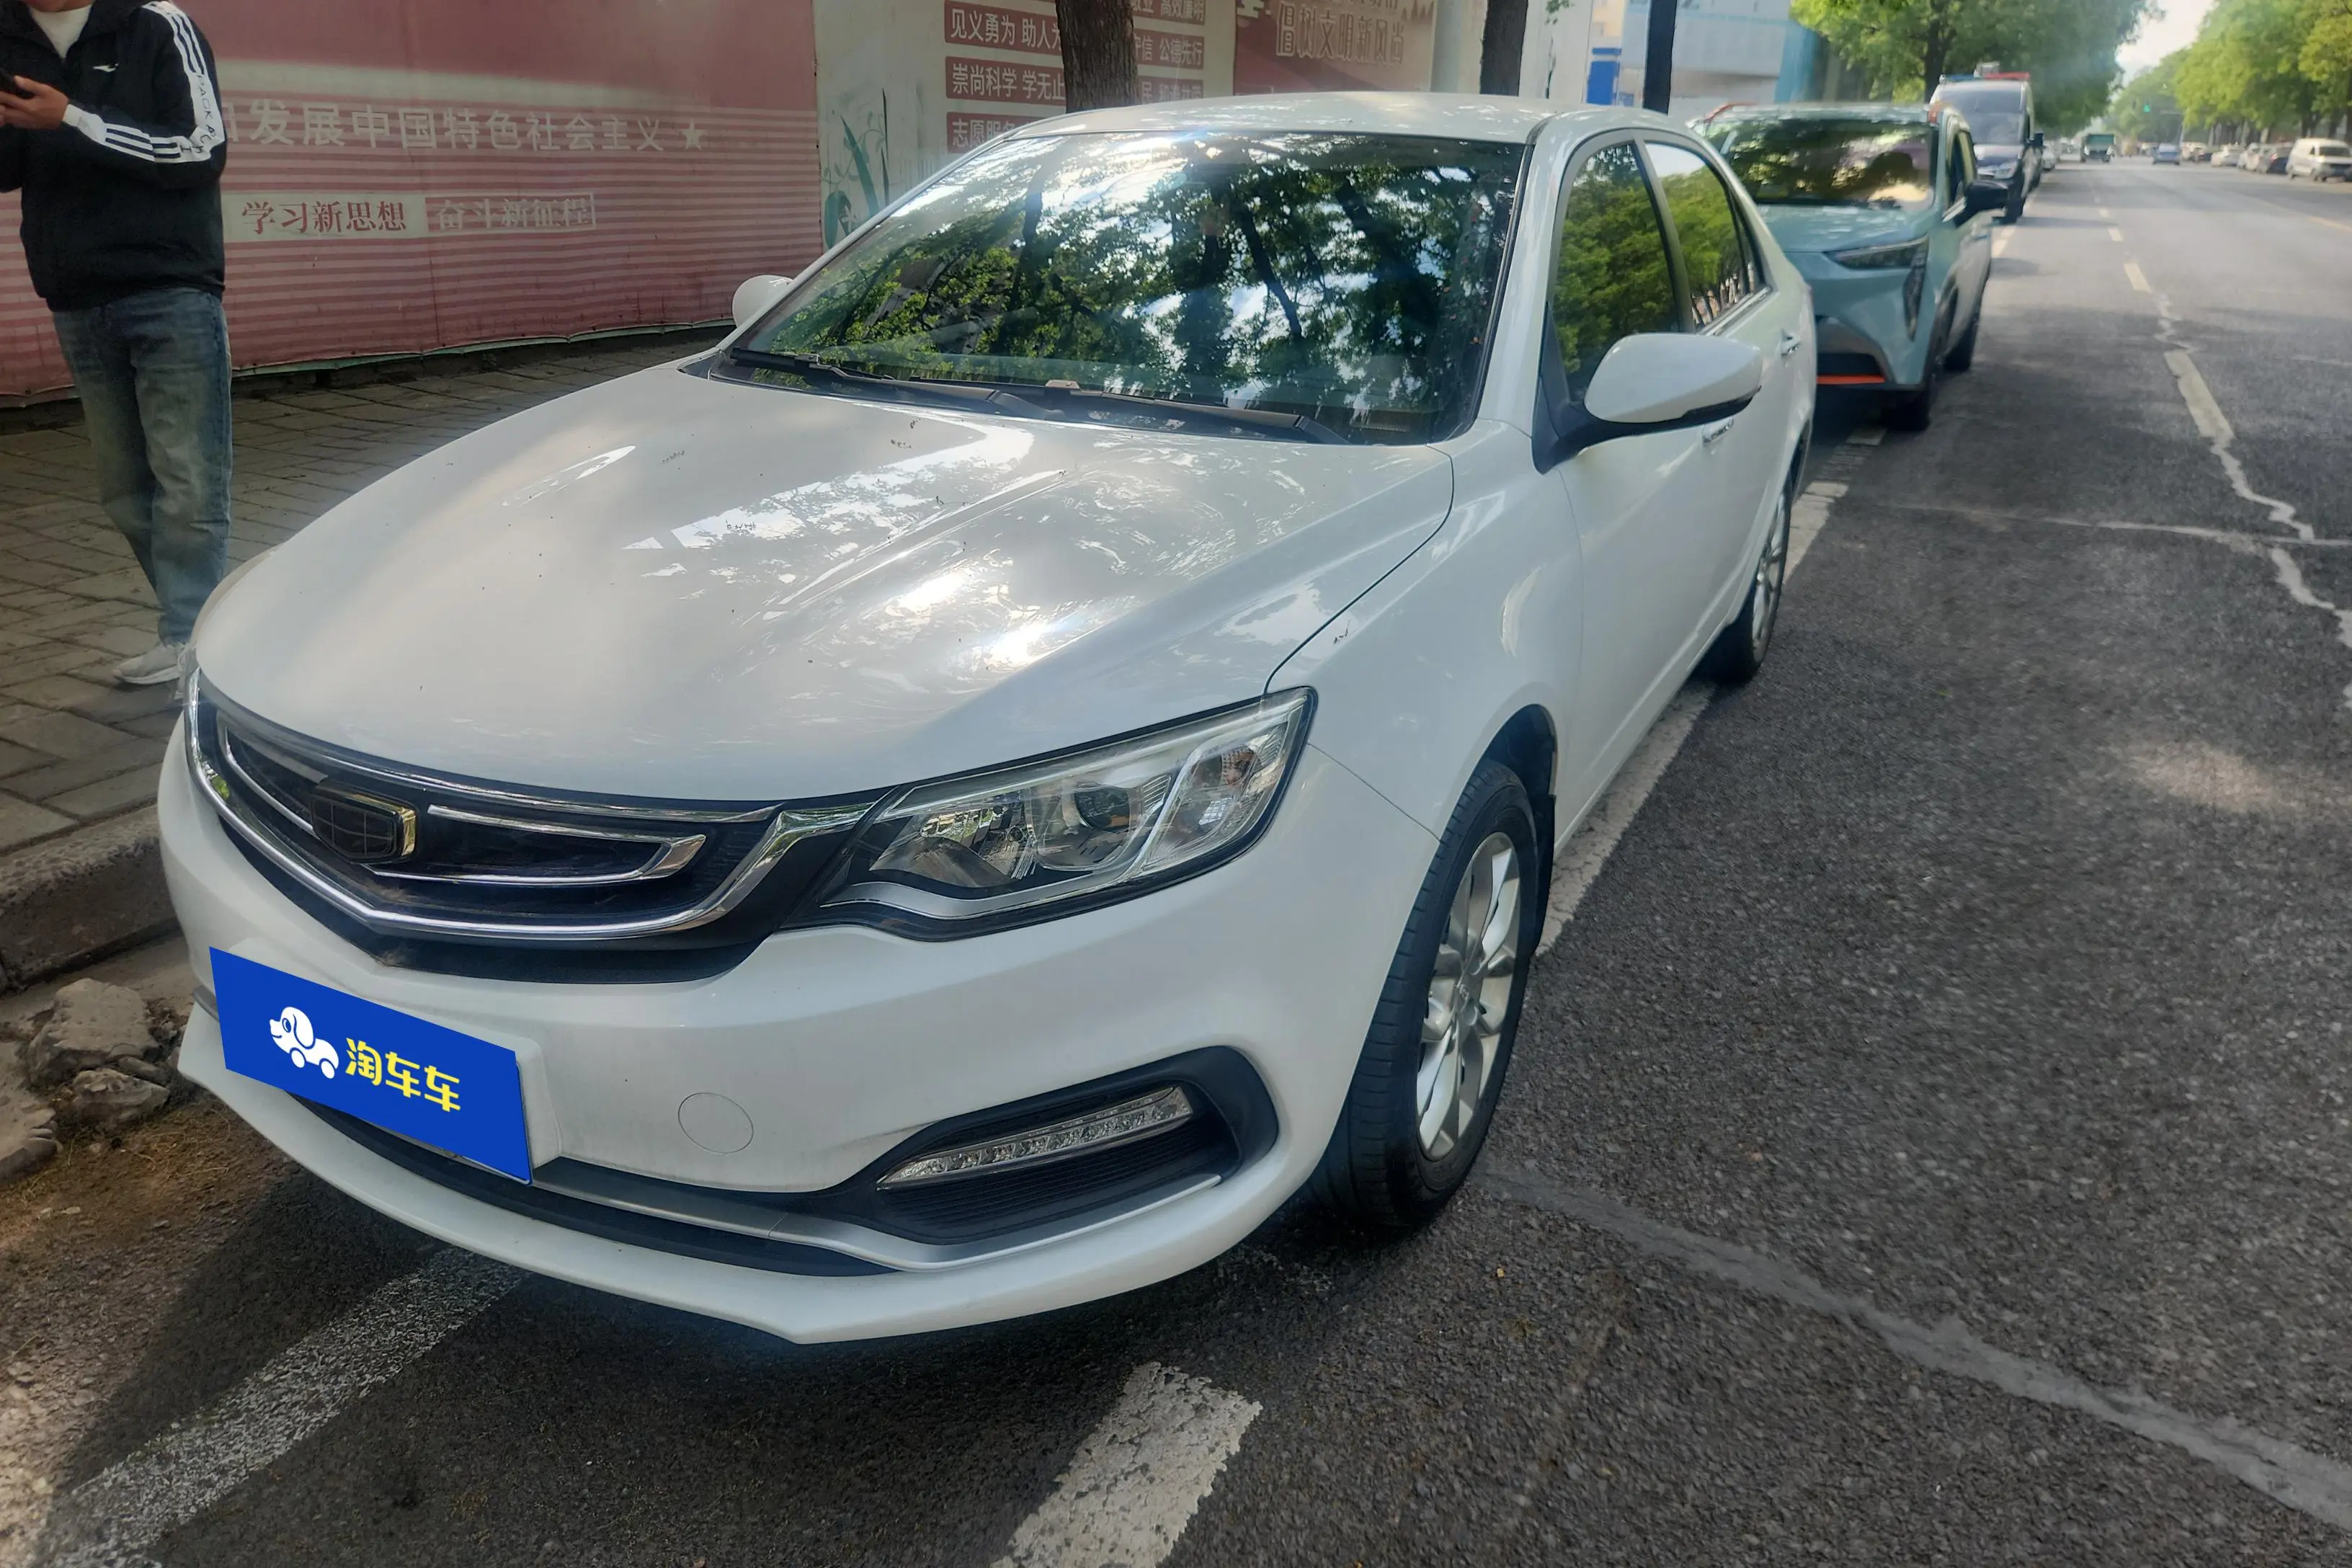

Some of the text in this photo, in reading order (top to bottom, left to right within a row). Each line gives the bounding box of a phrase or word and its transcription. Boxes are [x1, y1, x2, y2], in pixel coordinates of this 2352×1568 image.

[951, 9, 1015, 45] 见义勇为
[1159, 37, 1203, 66] 公德先行
[953, 63, 1017, 98] 崇尚科学
[241, 200, 406, 234] 学习新思想
